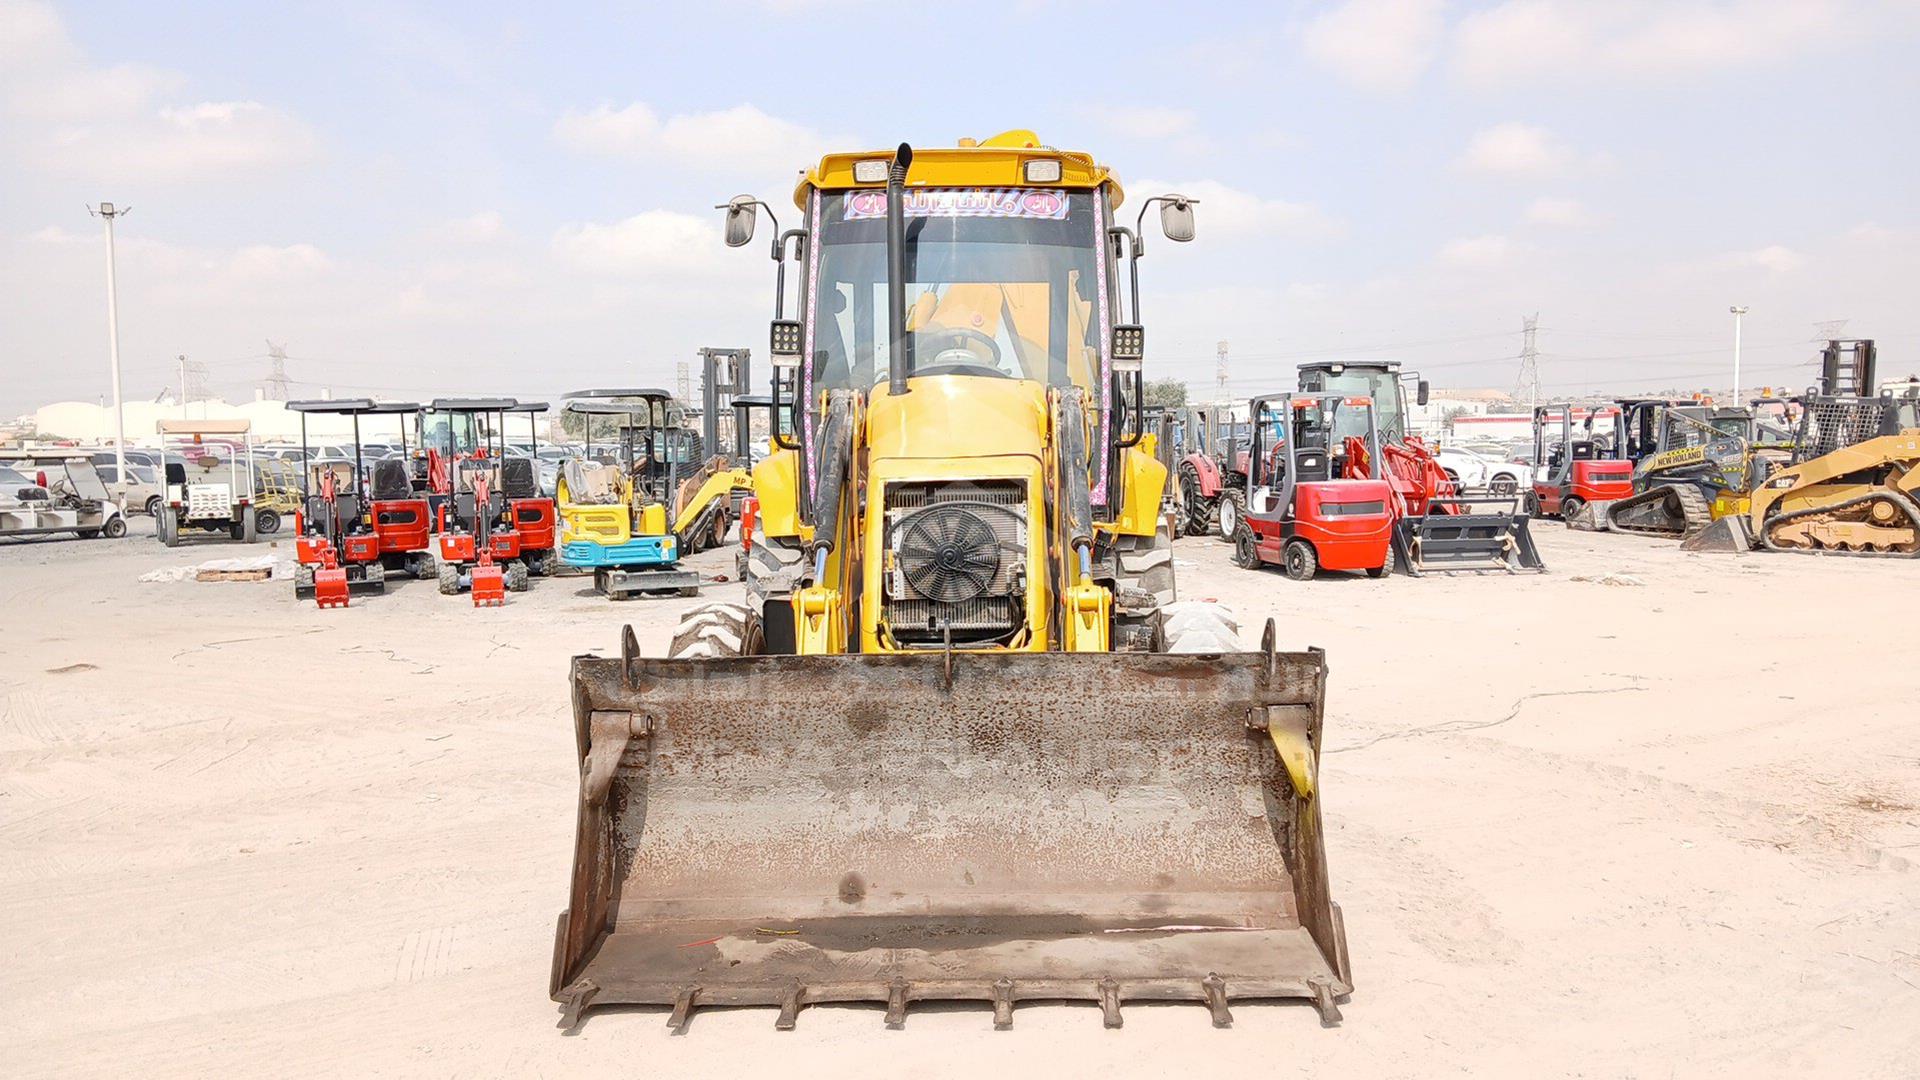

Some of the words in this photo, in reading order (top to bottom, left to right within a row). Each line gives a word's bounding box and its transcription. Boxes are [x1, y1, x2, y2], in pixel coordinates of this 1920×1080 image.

[1657, 457, 1672, 466] NEW
[1672, 450, 1702, 464] HOLLAND
[1776, 478, 1790, 488] CAT
